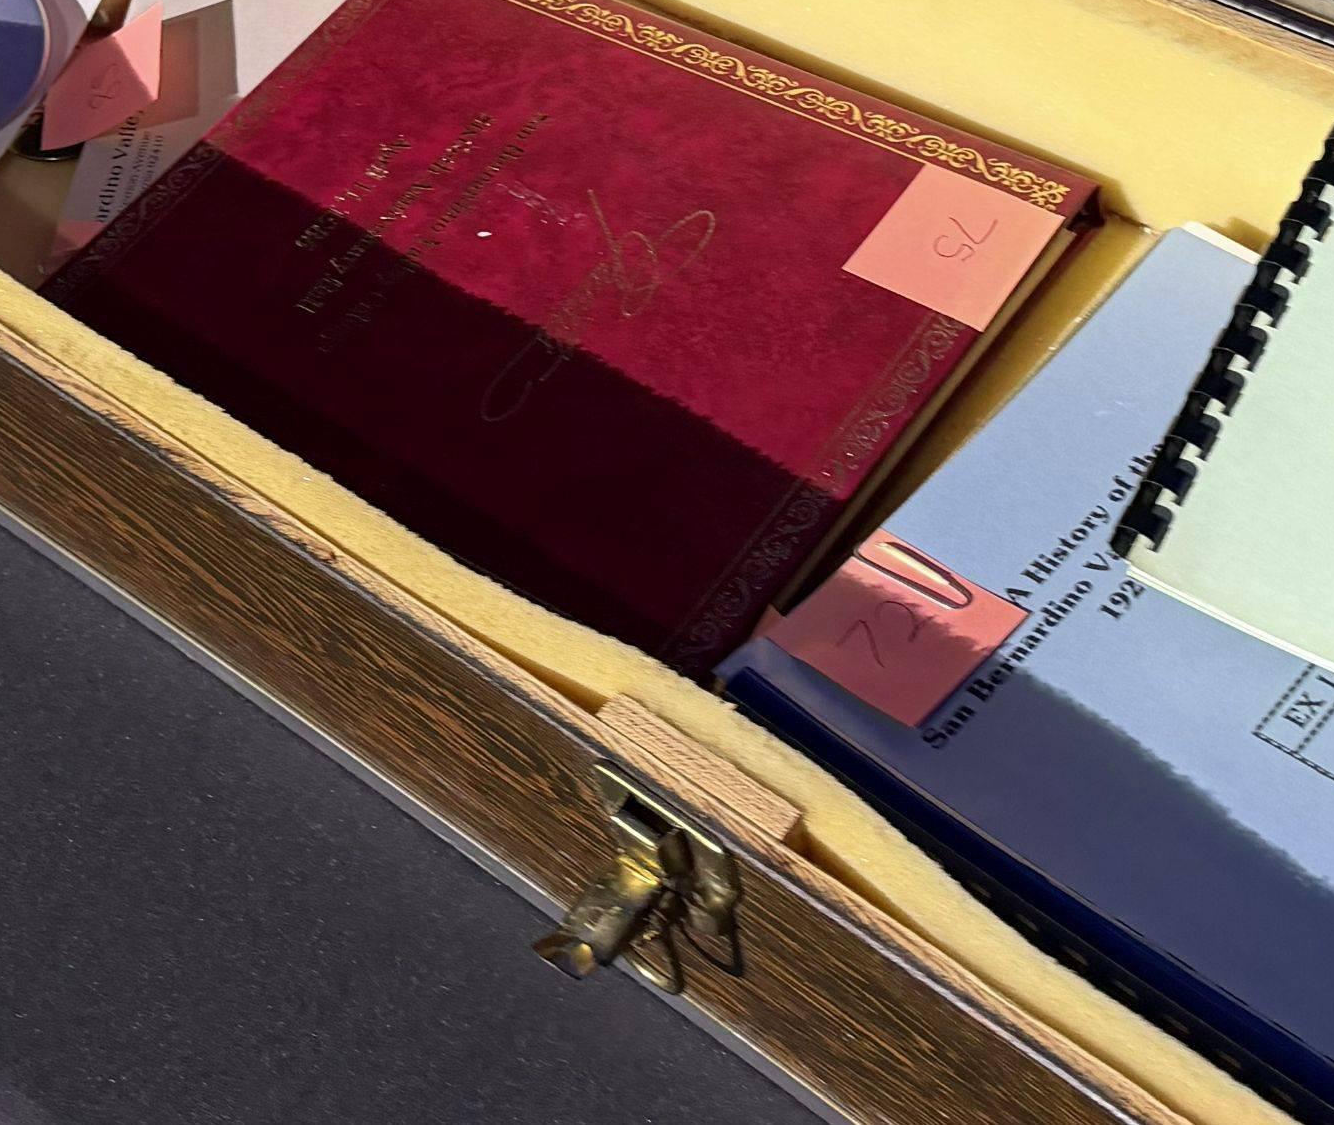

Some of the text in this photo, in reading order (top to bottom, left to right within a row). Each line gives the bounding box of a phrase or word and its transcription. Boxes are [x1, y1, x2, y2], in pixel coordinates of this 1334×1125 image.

[933, 215, 999, 262] 75
[1003, 586, 1034, 609] A
[1020, 505, 1110, 585] History
[1108, 475, 1135, 504] of
[1097, 577, 1147, 621] 192
[922, 702, 977, 750] San
[966, 578, 1094, 704] Bernardino
[1281, 691, 1328, 730] EX
